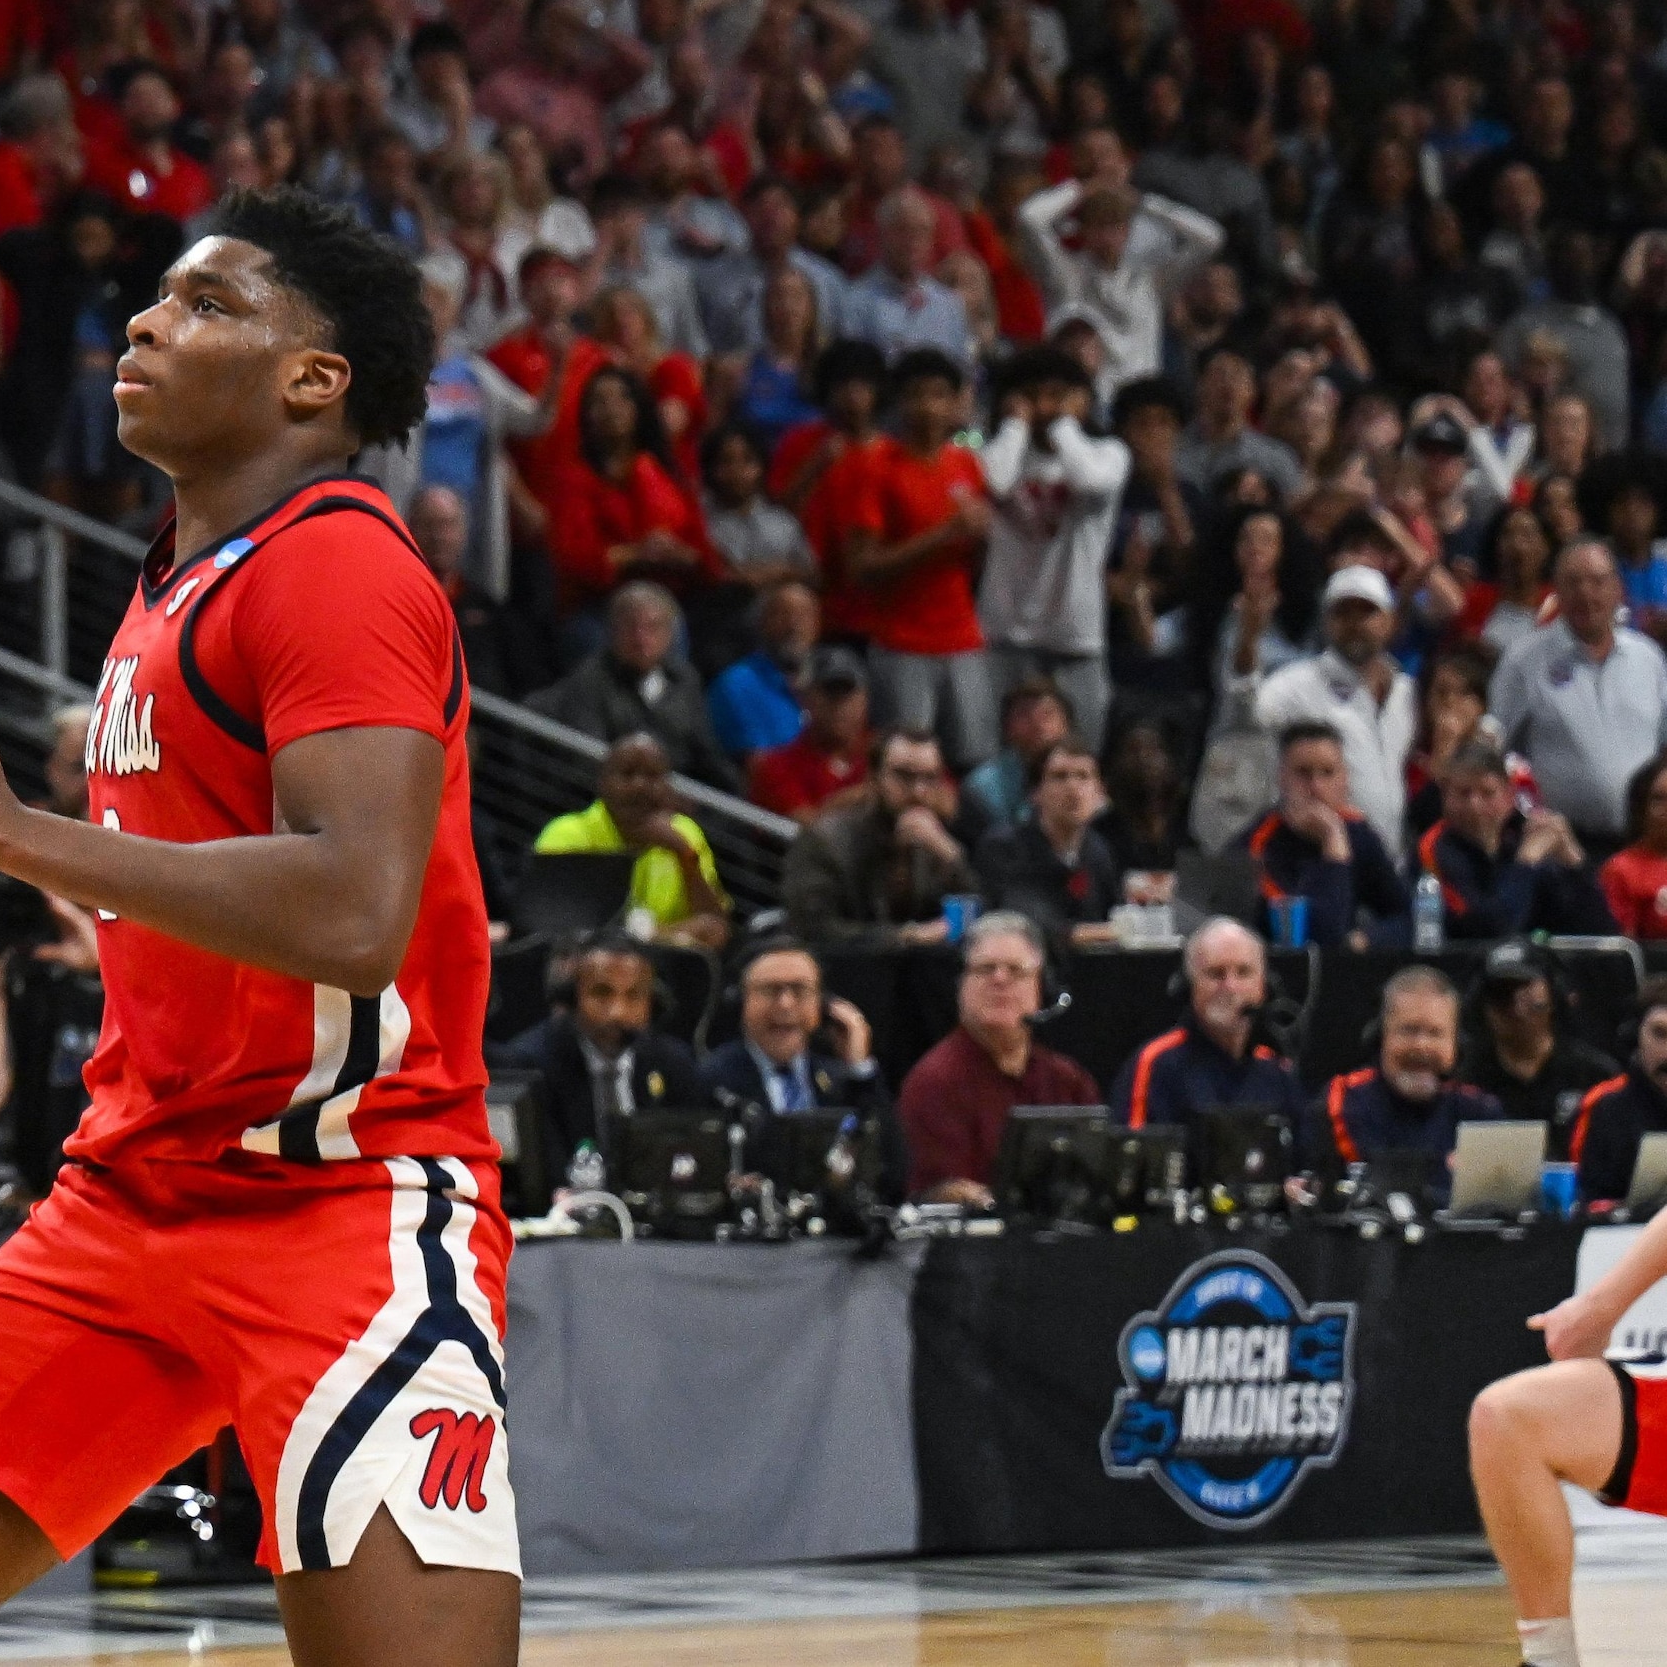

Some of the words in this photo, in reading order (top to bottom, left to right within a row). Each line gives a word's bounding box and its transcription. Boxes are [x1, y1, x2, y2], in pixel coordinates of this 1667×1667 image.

[1166, 1325, 1290, 1383] MARCH
[1181, 1380, 1345, 1441] MADNESS
[409, 1407, 497, 1515] M
